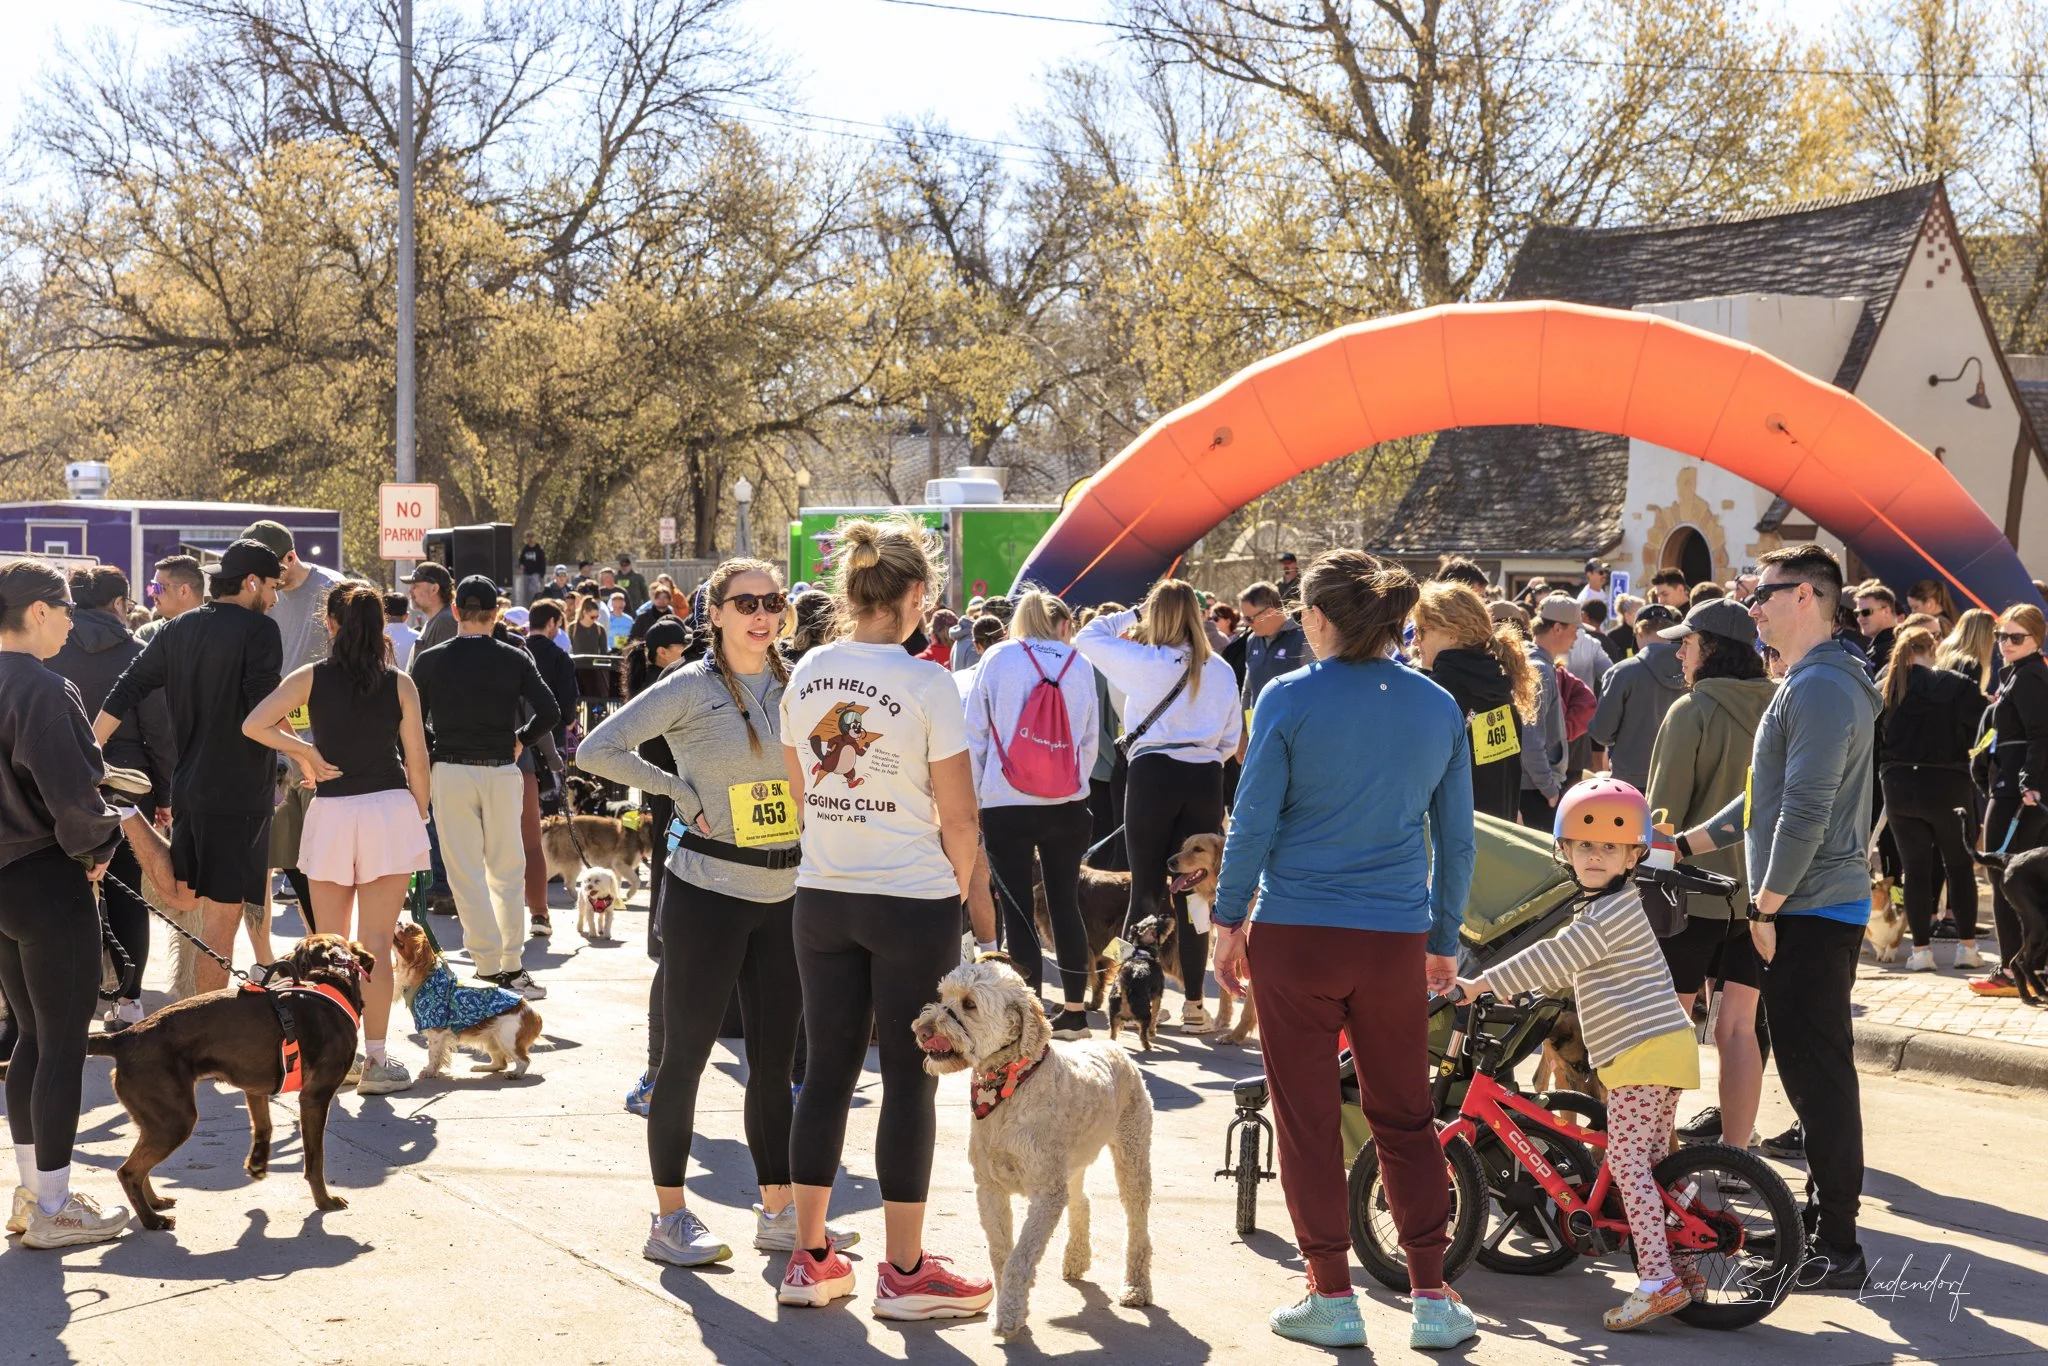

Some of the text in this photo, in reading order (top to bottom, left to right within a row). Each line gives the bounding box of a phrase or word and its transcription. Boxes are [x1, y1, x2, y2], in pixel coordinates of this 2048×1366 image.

[396, 501, 422, 518] NO
[384, 528, 433, 541] PARKIN
[800, 677, 902, 717] 54TH HELO SQ
[1496, 710, 1505, 721] 5K
[1487, 725, 1507, 747] 469
[771, 783, 784, 796] 5K
[854, 798, 897, 813] CLUB
[752, 801, 787, 826] 453
[816, 811, 867, 823] MINOT AFB
